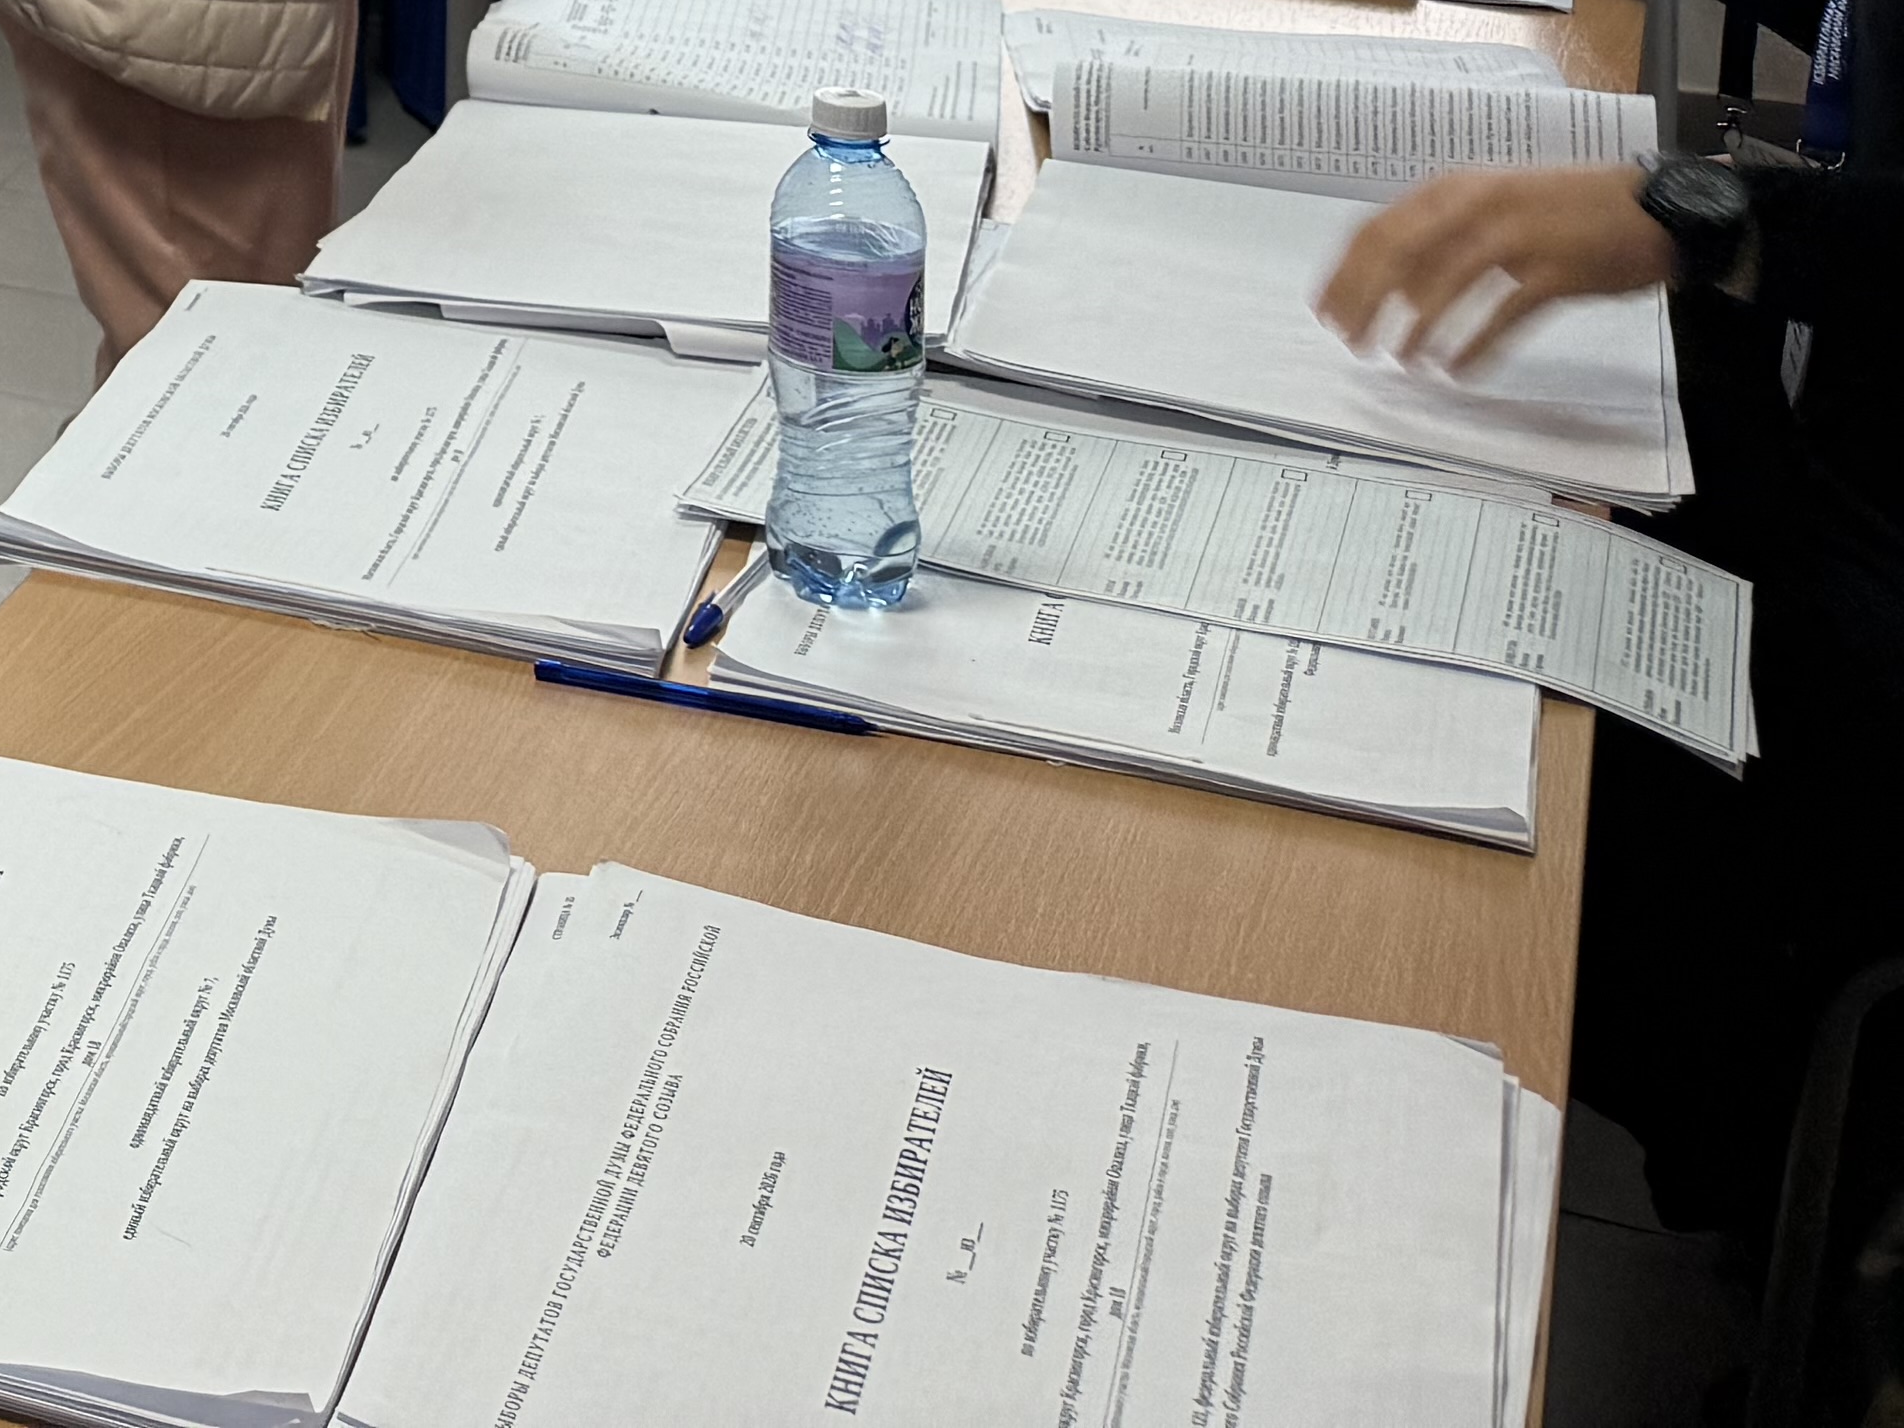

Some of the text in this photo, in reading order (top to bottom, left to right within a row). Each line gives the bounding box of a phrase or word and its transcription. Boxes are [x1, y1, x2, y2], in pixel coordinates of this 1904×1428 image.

[517, 1300, 564, 1382] ДЕПУТАТОВ
[551, 1179, 613, 1300] ГОСУДАРСТВЕННОЙ
[603, 1141, 632, 1180] ДУМЫ
[620, 1049, 668, 1140] ФЕДЕРАЛЬНОГО
[657, 993, 693, 1048] СОБРАНИЯ
[680, 924, 722, 994] РОССИЙСКОЙ
[596, 1074, 684, 1259] ФЕДЕРАЦИИ ДЕВЯТОГО СОЗЫВА
[823, 1066, 953, 1416] КНИГА СПИСКА ИЗБИРАТЕЛЕЙ
